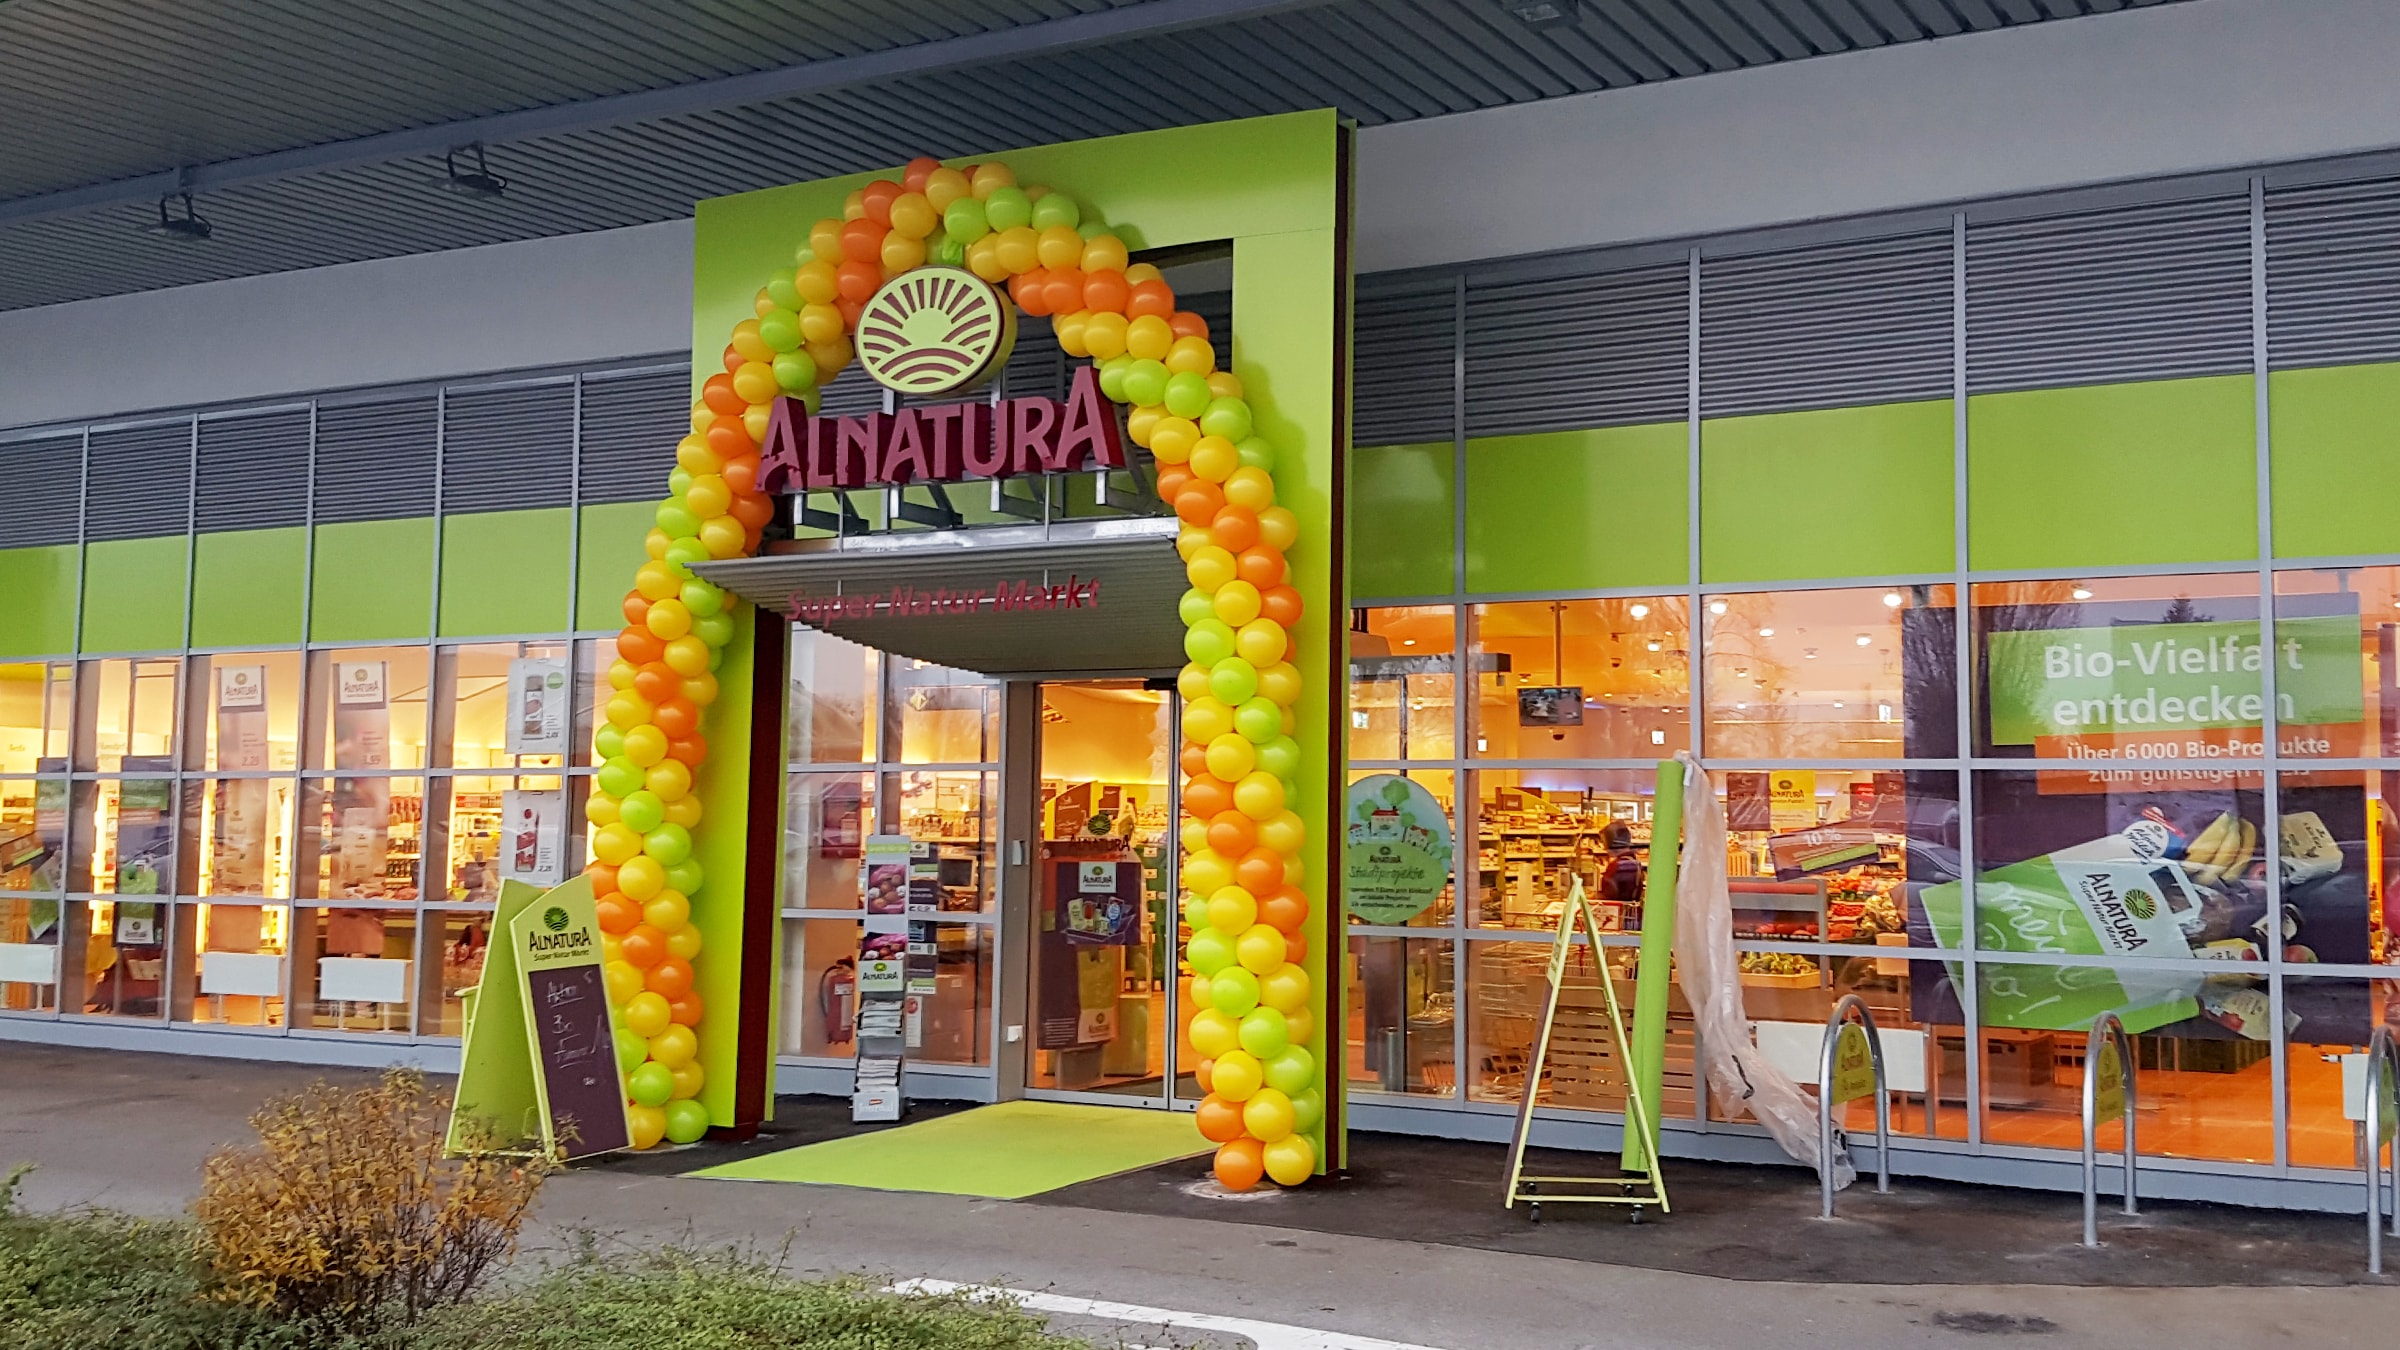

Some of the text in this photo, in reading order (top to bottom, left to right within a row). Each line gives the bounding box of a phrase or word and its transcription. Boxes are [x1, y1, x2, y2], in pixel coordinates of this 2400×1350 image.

[754, 366, 1118, 493] ALNATURA
[785, 574, 1100, 628] Super Natur Markt
[2044, 635, 2303, 679] Bio-Vielfat
[2067, 742, 2118, 759] Über
[2187, 736, 2330, 758] Bio-Proukte
[2089, 769, 2133, 783] zum
[1803, 828, 1843, 848] 10 %
[2078, 880, 2123, 949] Super Natur Markt
[2085, 872, 2149, 952] ALNATURA
[529, 927, 592, 951] ALNATURA
[534, 952, 553, 962] Super
